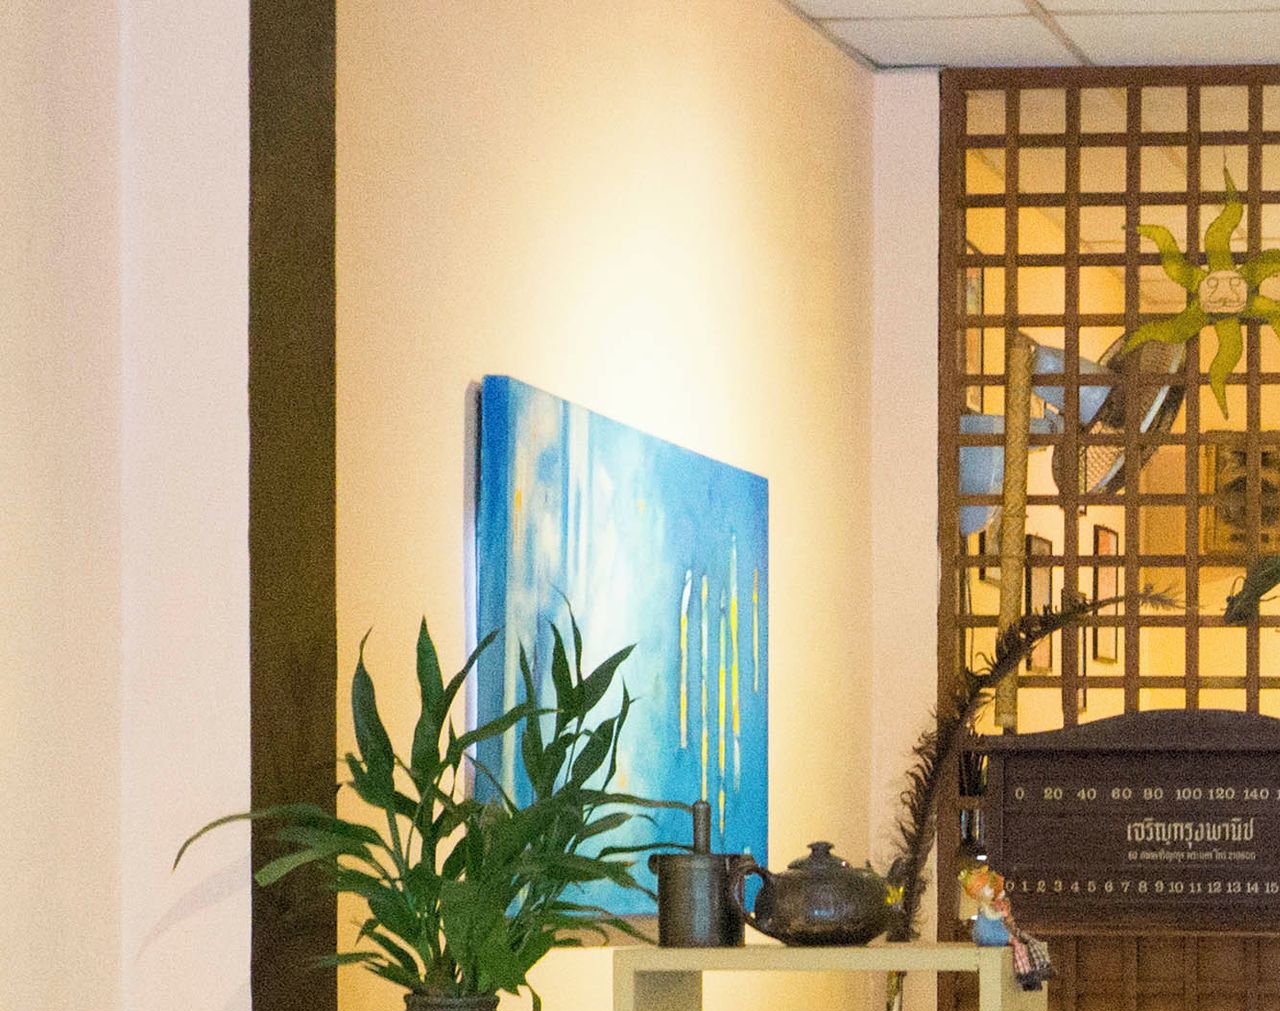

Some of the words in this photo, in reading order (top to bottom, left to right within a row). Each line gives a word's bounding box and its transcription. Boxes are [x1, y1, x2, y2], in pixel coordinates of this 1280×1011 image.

[1015, 787, 1025, 801] 0
[1043, 787, 1063, 801] 20
[1076, 787, 1097, 801] 40
[1111, 787, 1132, 801] 60
[1143, 787, 1164, 801] 80
[1176, 787, 1202, 801] 100
[1208, 787, 1235, 801] 120
[1244, 787, 1269, 801] 140
[1005, 880, 1015, 893] 0
[1021, 880, 1029, 893] 1
[1036, 880, 1046, 893] 2
[1053, 880, 1063, 893] 3
[1070, 880, 1079, 893] 4
[1087, 880, 1096, 893] 5
[1104, 880, 1114, 893] 6
[1121, 880, 1130, 893] 7
[1138, 880, 1148, 893] 8
[1154, 880, 1164, 893] 9
[1168, 880, 1184, 893] 10
[1189, 880, 1201, 893] 11
[1208, 881, 1222, 894] 12
[1227, 881, 1241, 894] 13
[1246, 881, 1259, 894] 14
[1265, 881, 1279, 894] 15
